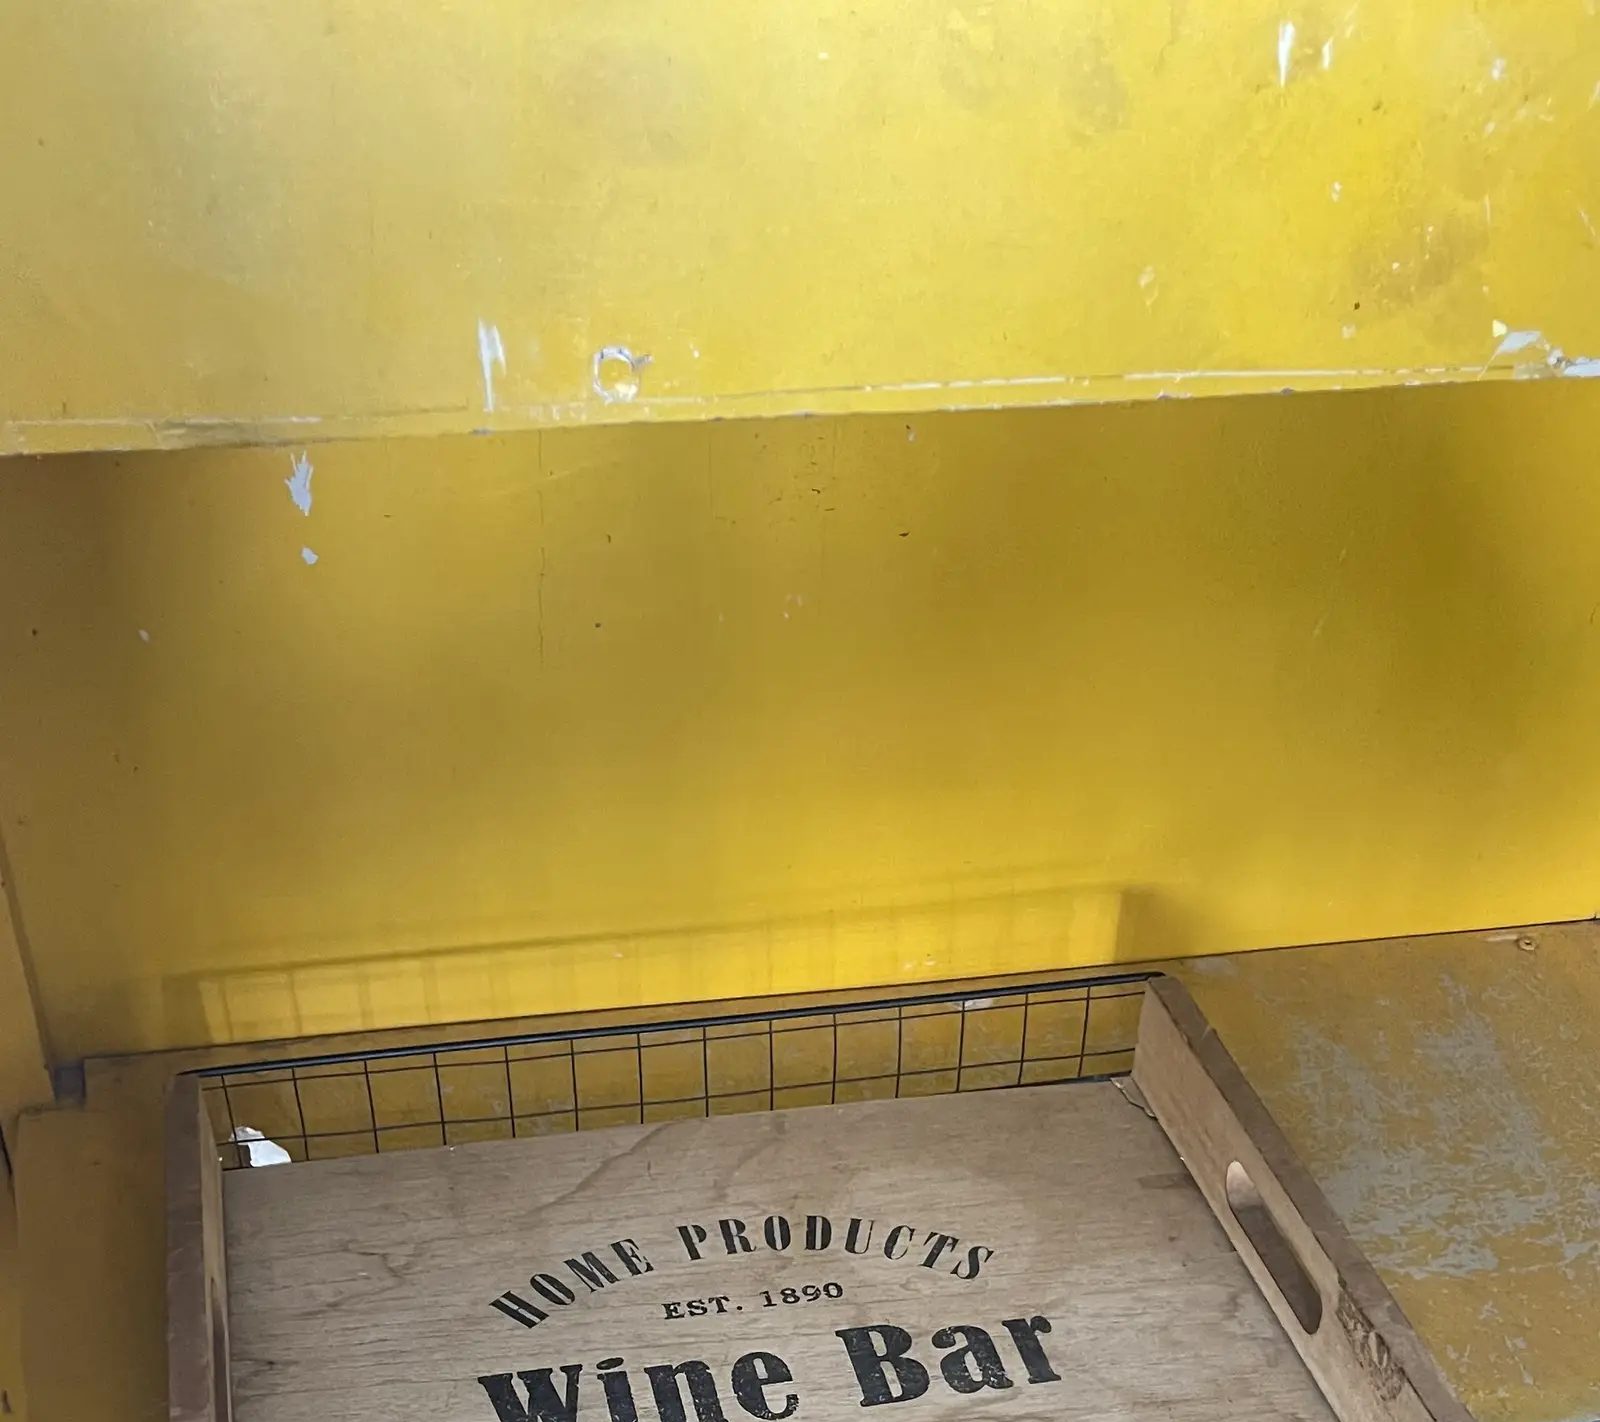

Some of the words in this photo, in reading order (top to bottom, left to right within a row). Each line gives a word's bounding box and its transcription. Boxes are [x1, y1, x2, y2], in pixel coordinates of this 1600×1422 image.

[488, 1238, 654, 1329] HOME
[676, 1214, 994, 1280] PRODUCTS
[661, 1295, 743, 1320] EST.
[761, 1281, 844, 1308] 1890
[835, 1314, 1062, 1408] Bar
